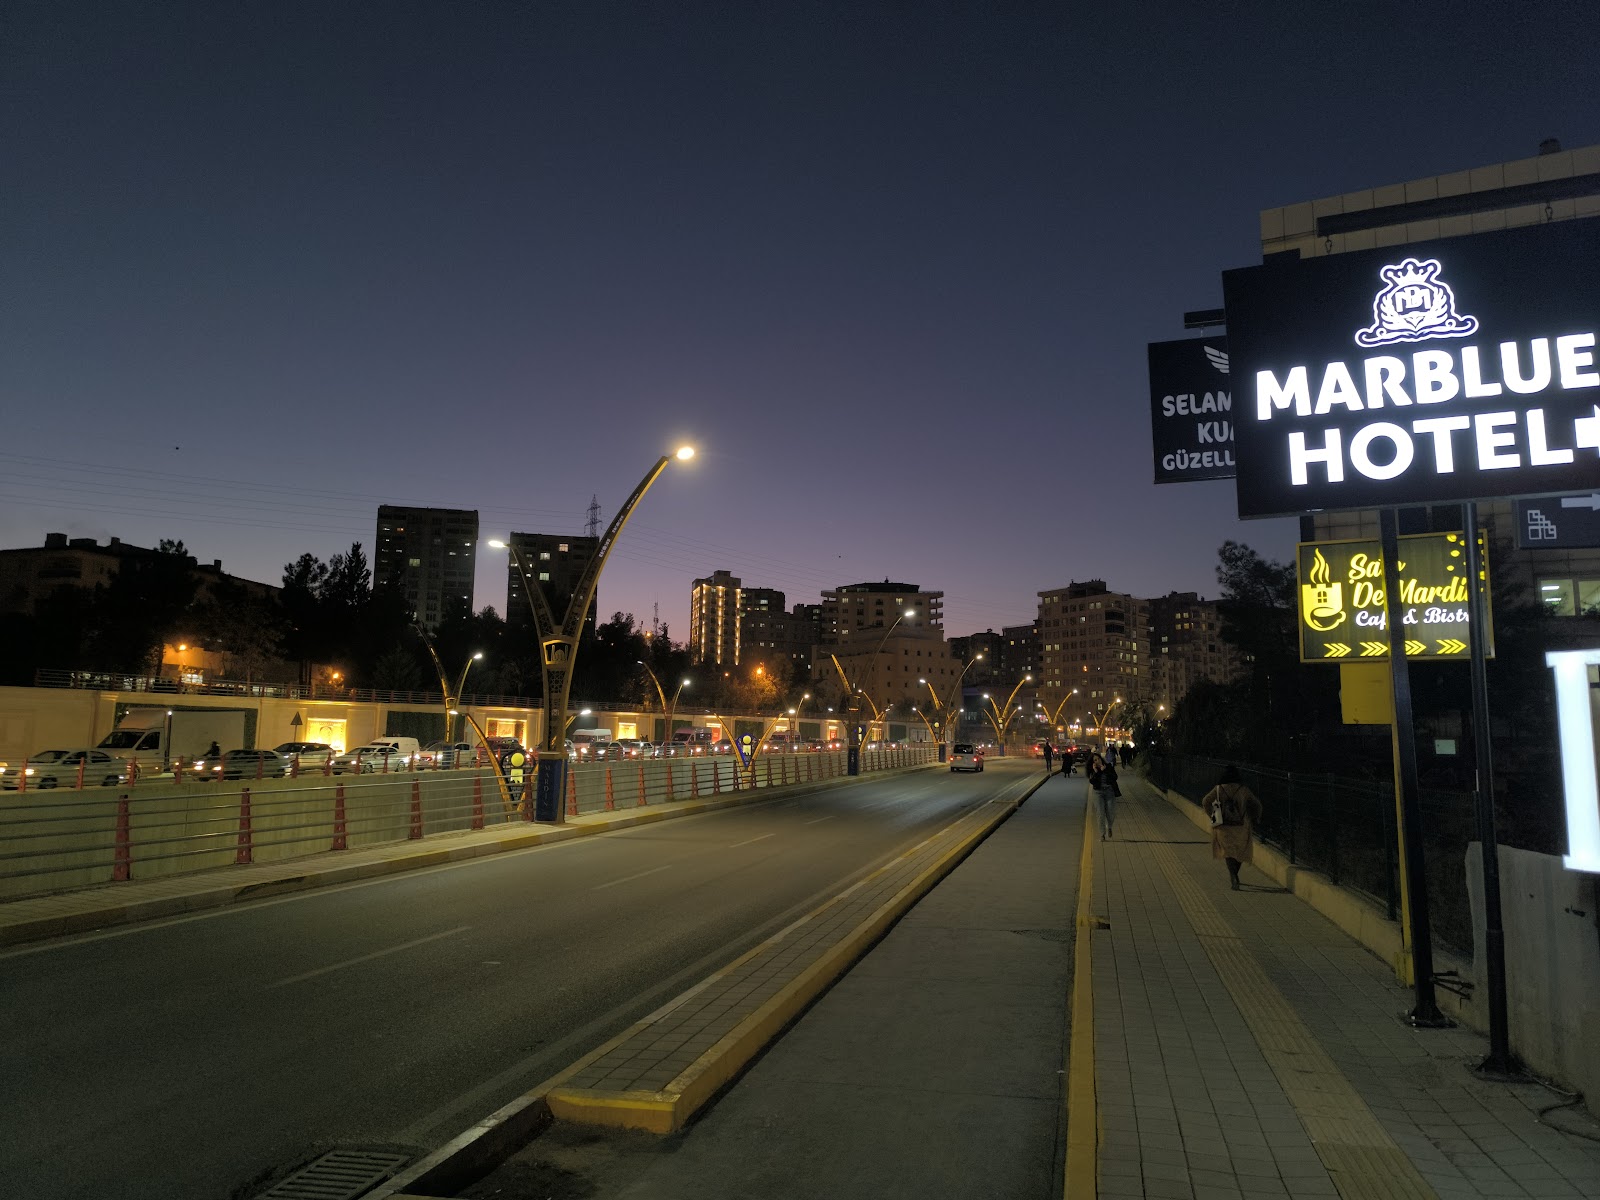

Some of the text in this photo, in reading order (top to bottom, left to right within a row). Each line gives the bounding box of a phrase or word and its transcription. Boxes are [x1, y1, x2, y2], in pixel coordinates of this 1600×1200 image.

[1256, 332, 1600, 421] MARBLUE
[1198, 421, 1234, 444] KU
[1288, 408, 1574, 485] HOTEL
[1356, 607, 1470, 630] Caf & Bistr
